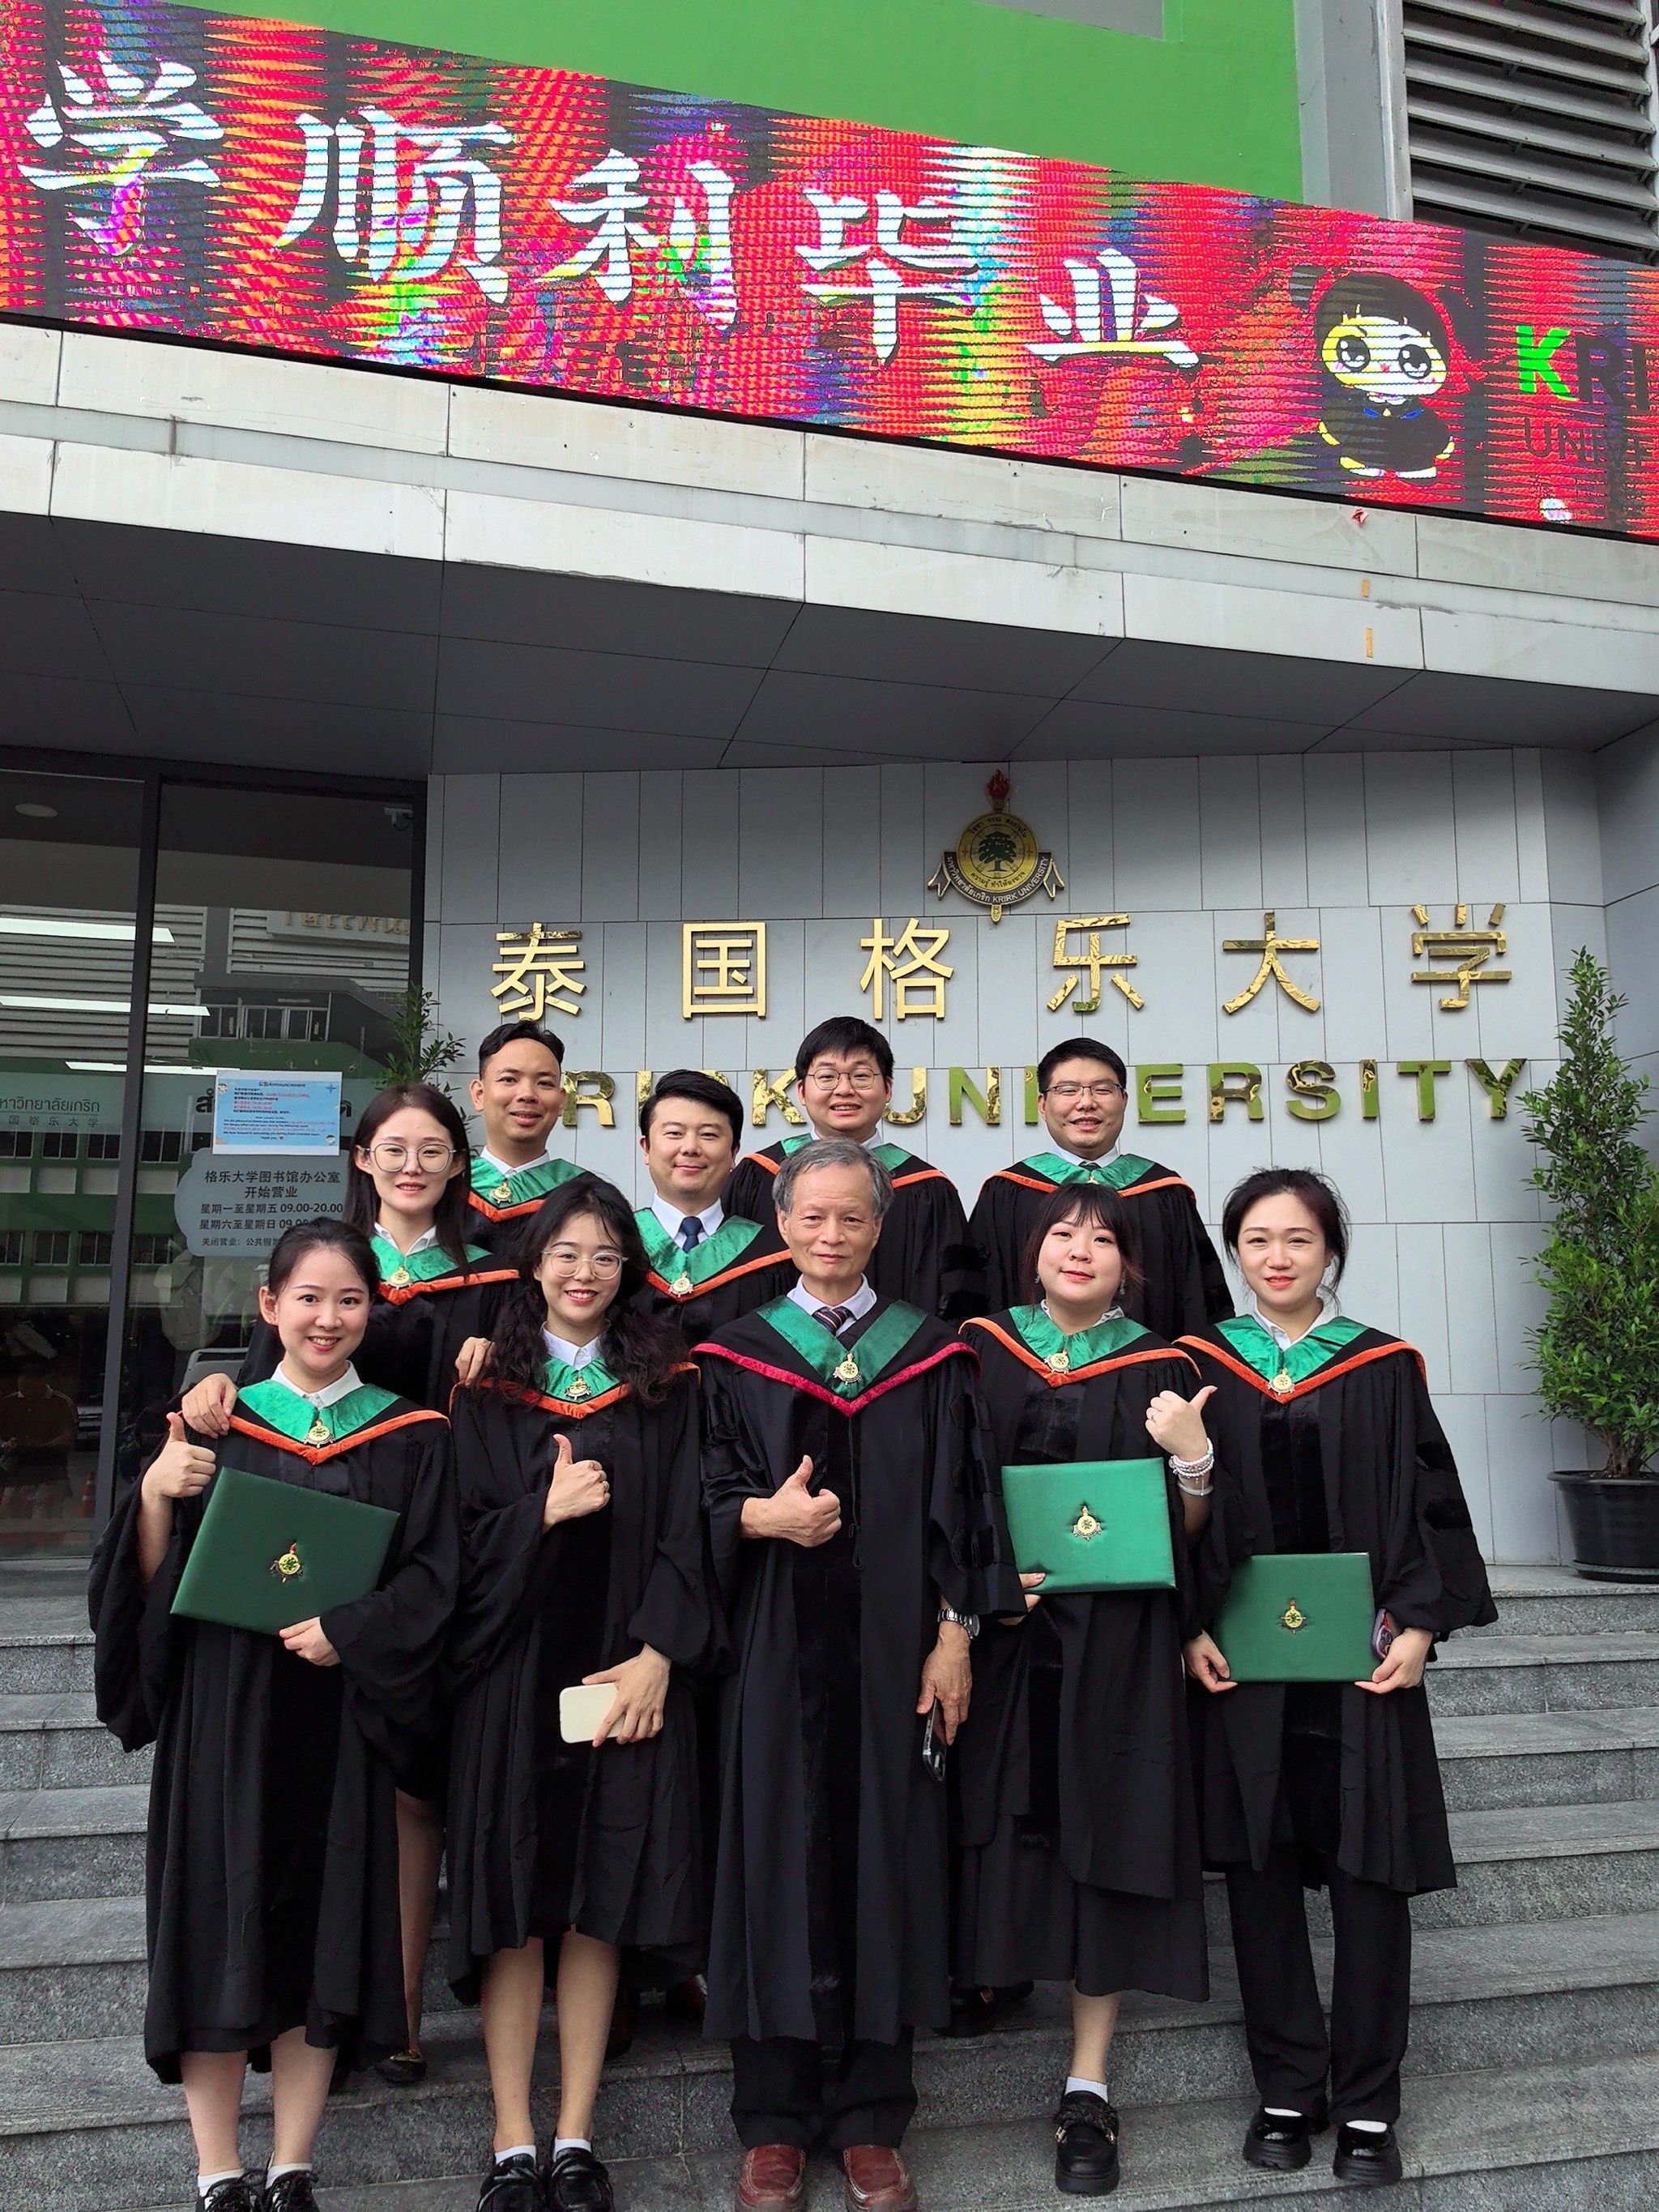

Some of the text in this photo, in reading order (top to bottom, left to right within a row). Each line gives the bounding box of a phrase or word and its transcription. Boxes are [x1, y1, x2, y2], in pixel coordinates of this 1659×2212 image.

[992, 892, 1018, 903] KRIRK
[1019, 856, 1049, 897] UNIVERSITY
[490, 903, 1512, 1021] 泰国格乐大学
[561, 1058, 1529, 1127] RIK UNIERSITY
[204, 1170, 341, 1184] 格乐大学图书馆办公室
[244, 1186, 298, 1198] 开始营业
[200, 1203, 343, 1214] 星期一至星期五 09.00-20.00
[199, 1219, 276, 1230] 星期六至星期日
